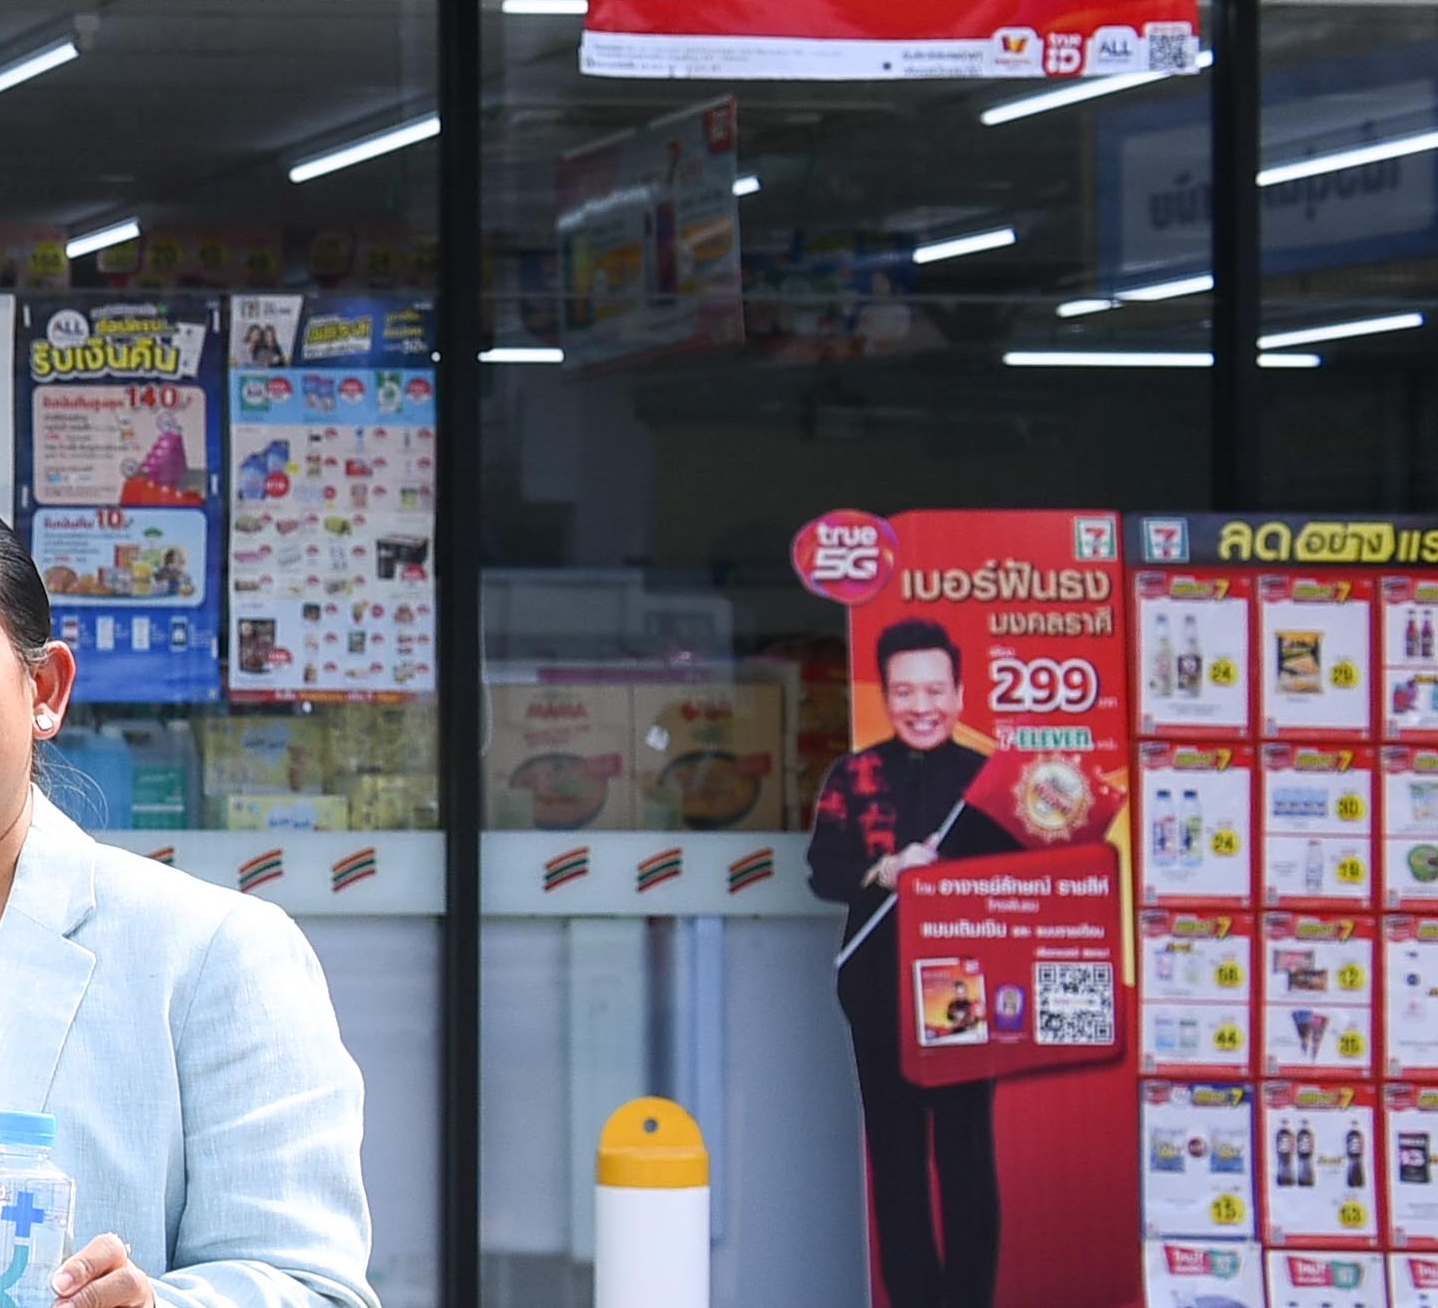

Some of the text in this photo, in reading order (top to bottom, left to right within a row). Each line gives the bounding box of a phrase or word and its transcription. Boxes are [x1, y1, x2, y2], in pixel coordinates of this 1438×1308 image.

[819, 523, 878, 546] true
[813, 547, 879, 581] 5G
[991, 658, 1098, 712] 299
